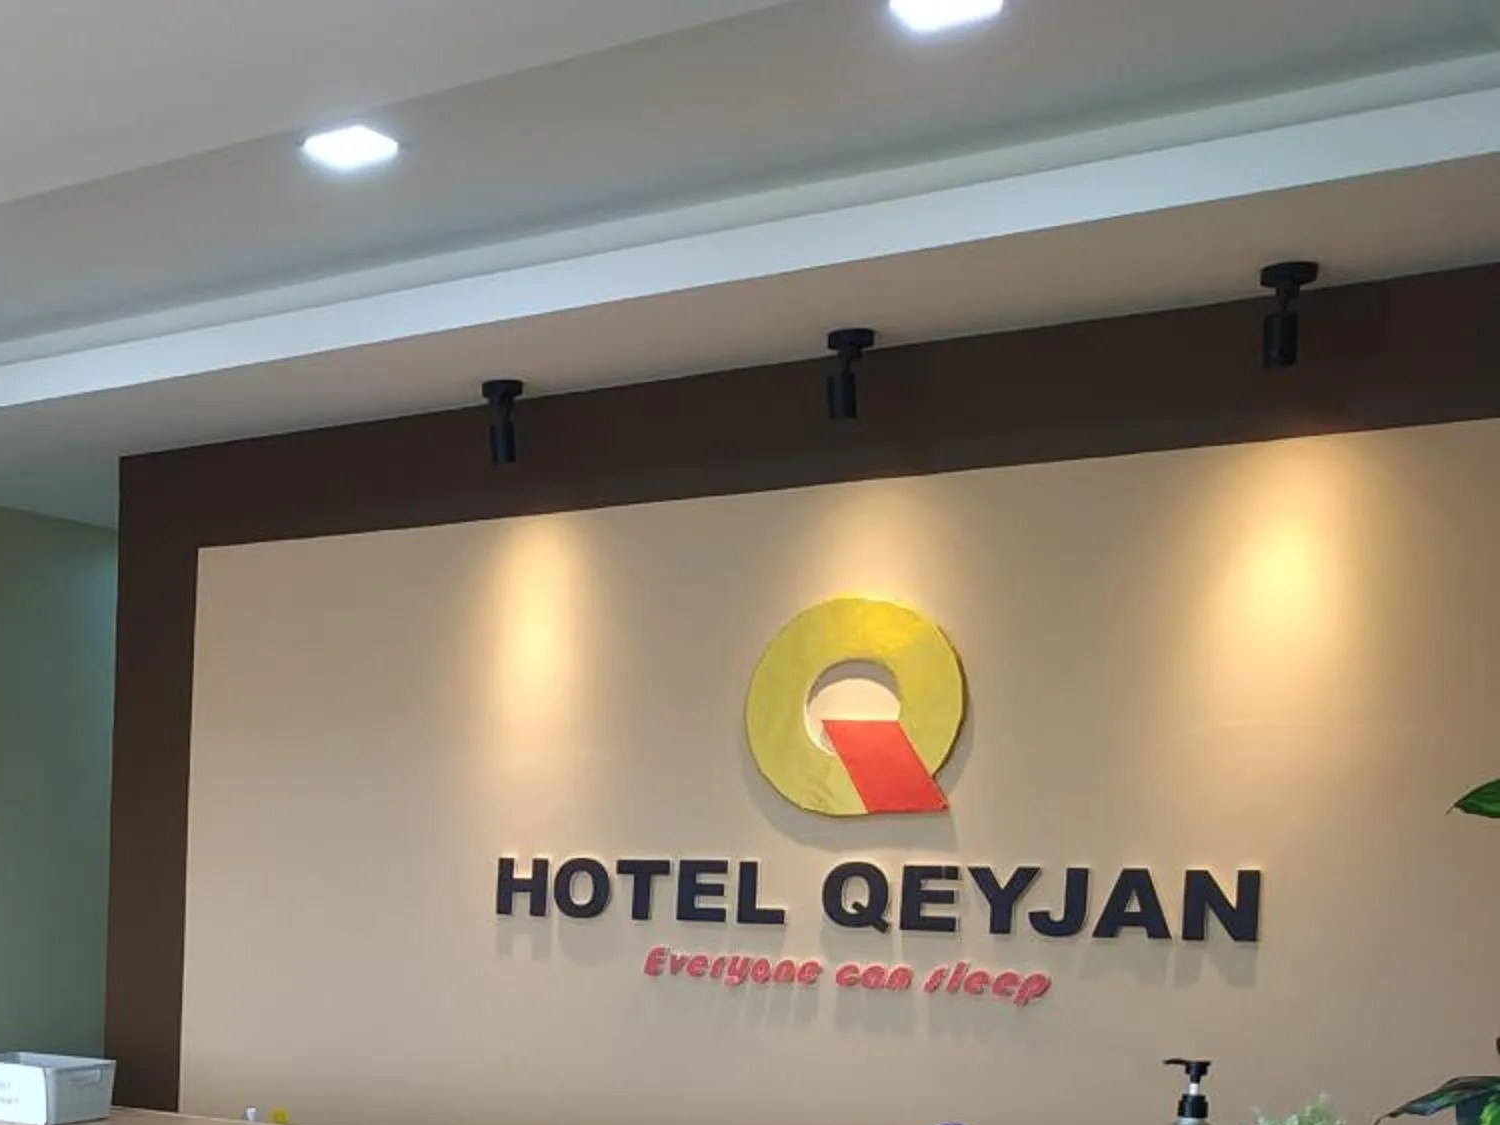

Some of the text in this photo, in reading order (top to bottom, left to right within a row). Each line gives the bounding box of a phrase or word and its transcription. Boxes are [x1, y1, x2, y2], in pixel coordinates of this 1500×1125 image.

[496, 857, 1262, 943] HOTEL QEYJAN
[643, 946, 1052, 1006] Everyone can sleep
